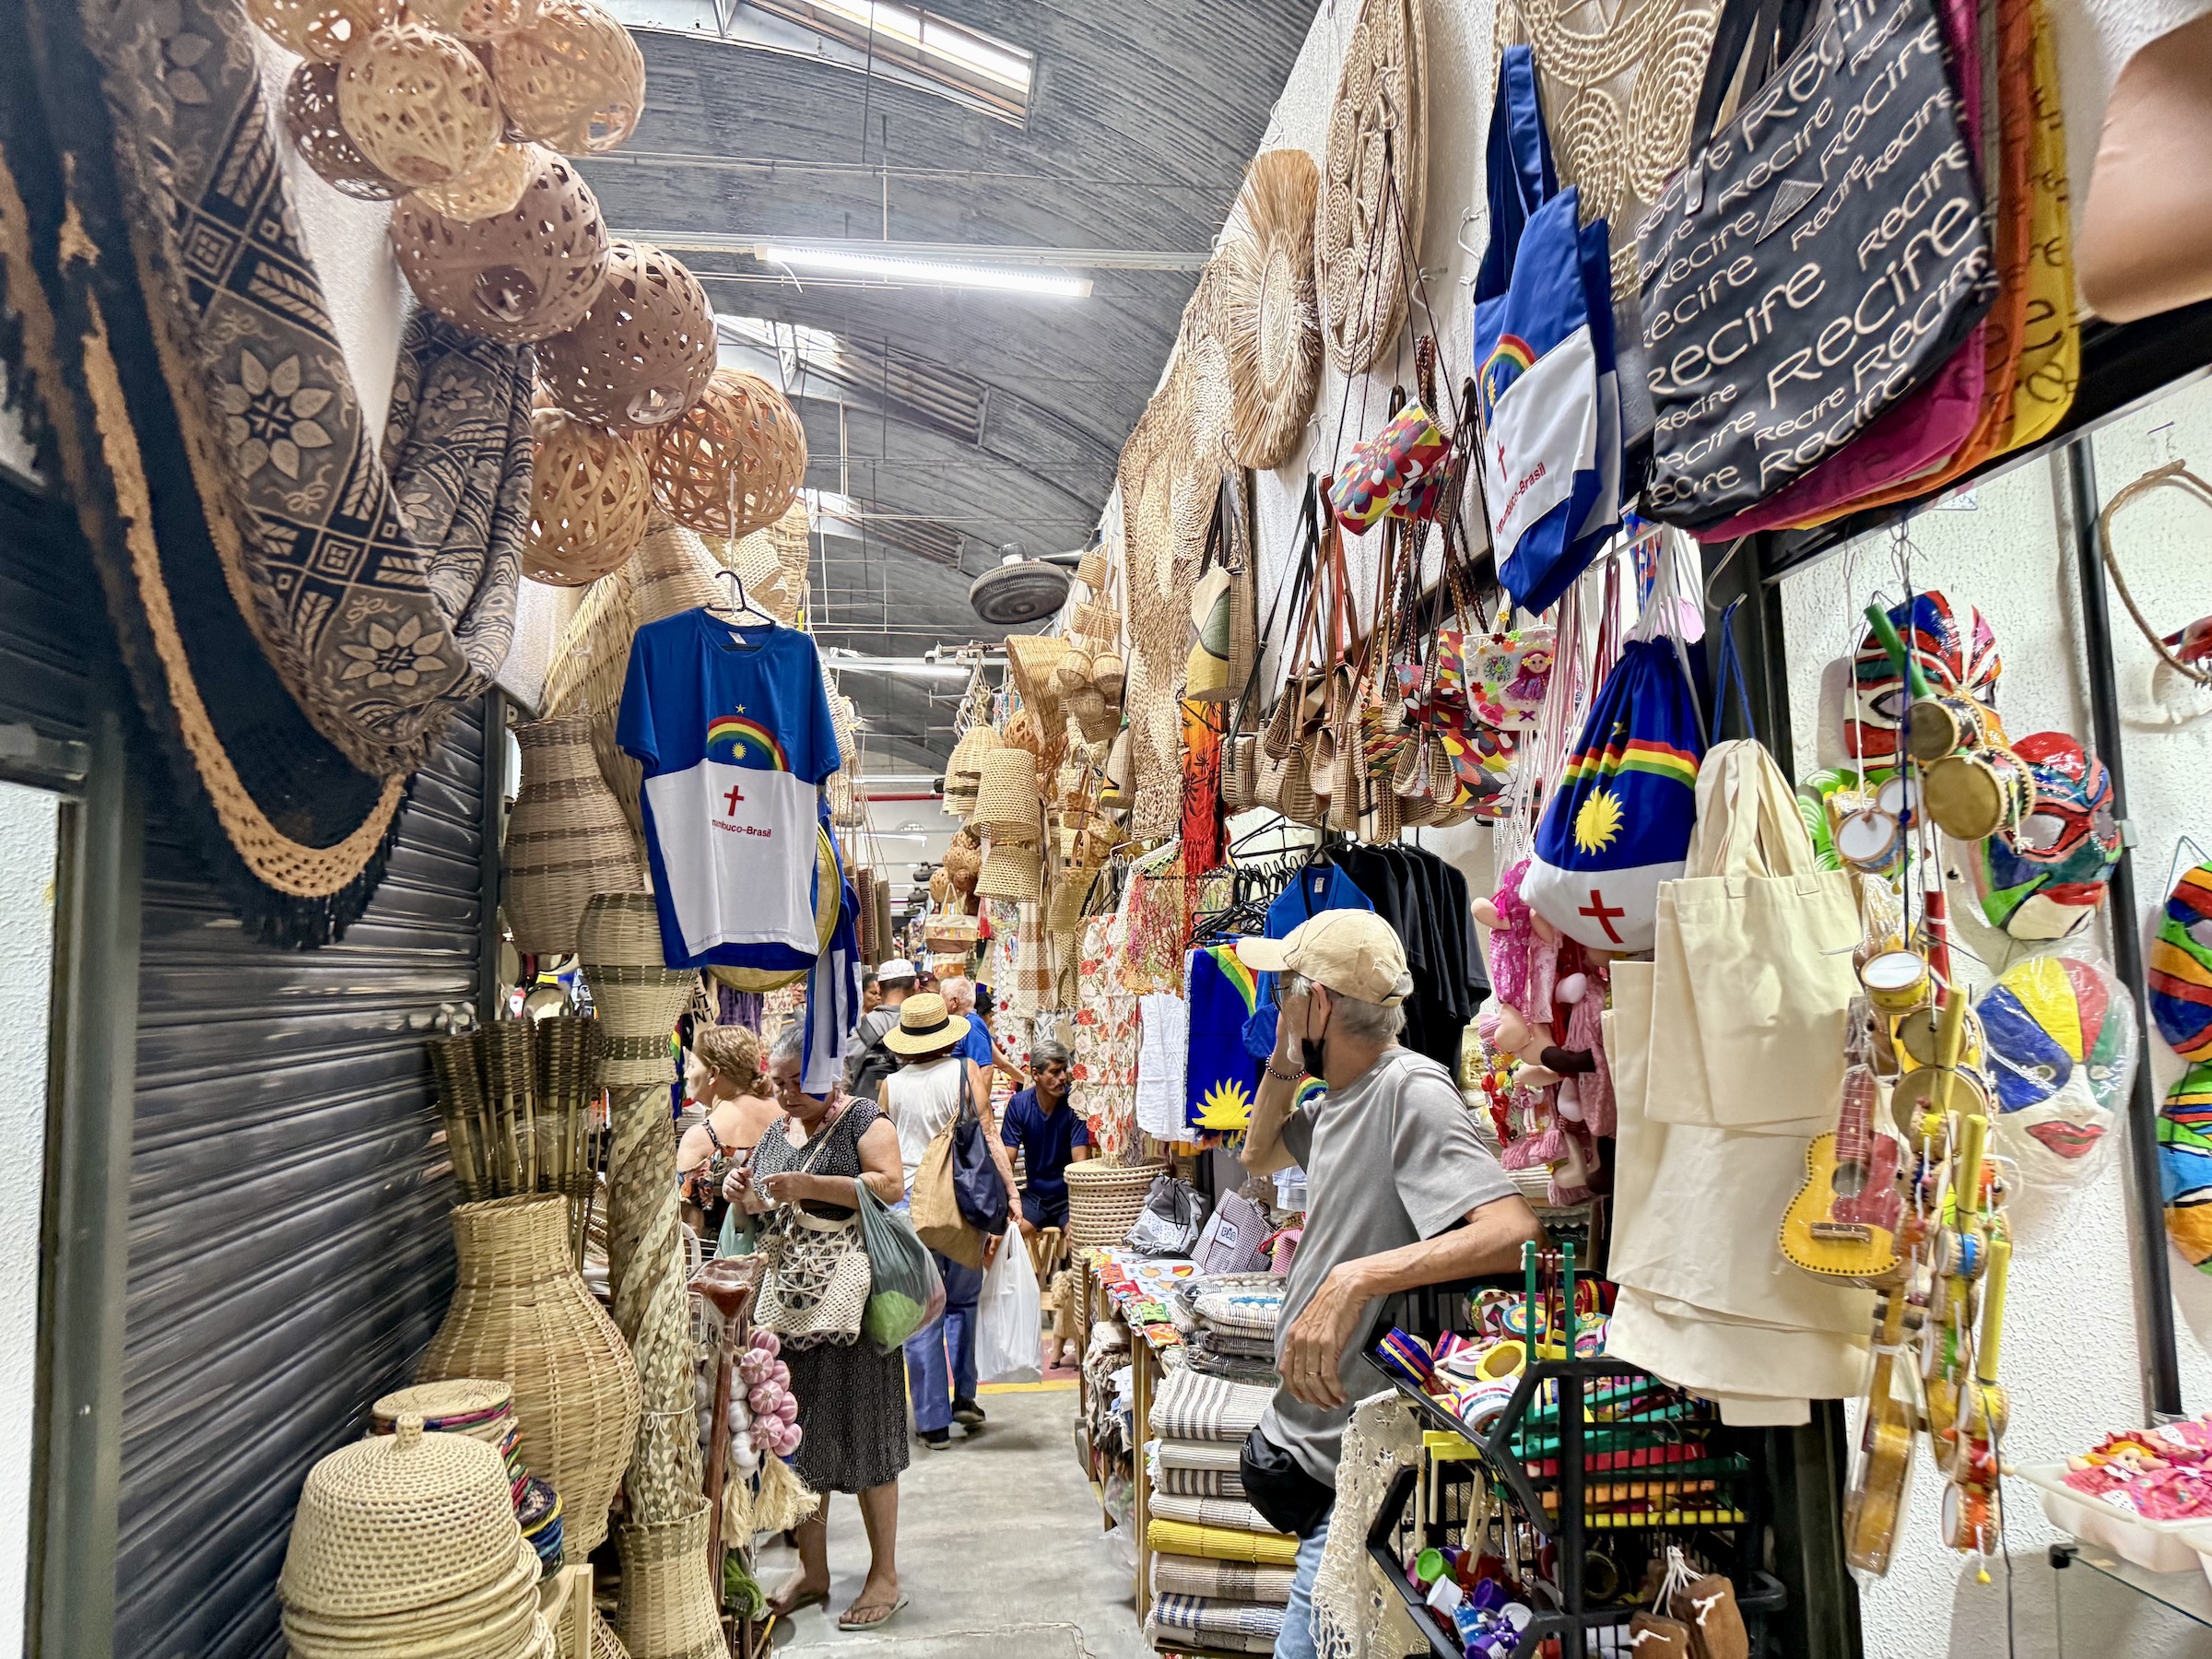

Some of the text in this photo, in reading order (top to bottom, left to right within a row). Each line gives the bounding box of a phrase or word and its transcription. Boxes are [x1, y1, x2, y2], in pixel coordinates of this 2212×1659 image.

[1820, 17, 1940, 182] Recife
[1865, 87, 1952, 190] Recife
[1717, 97, 1834, 216] Recife
[1791, 155, 1867, 252] Recife
[1857, 141, 1969, 272] Recife
[1639, 219, 1695, 284] ecife
[1653, 211, 1760, 304] Recife
[1767, 197, 1979, 409] Recife
[1654, 383, 1738, 432] Recife
[1753, 386, 1846, 451] Recife
[1759, 362, 1915, 491] Recife
[1649, 465, 1741, 508] ecife
